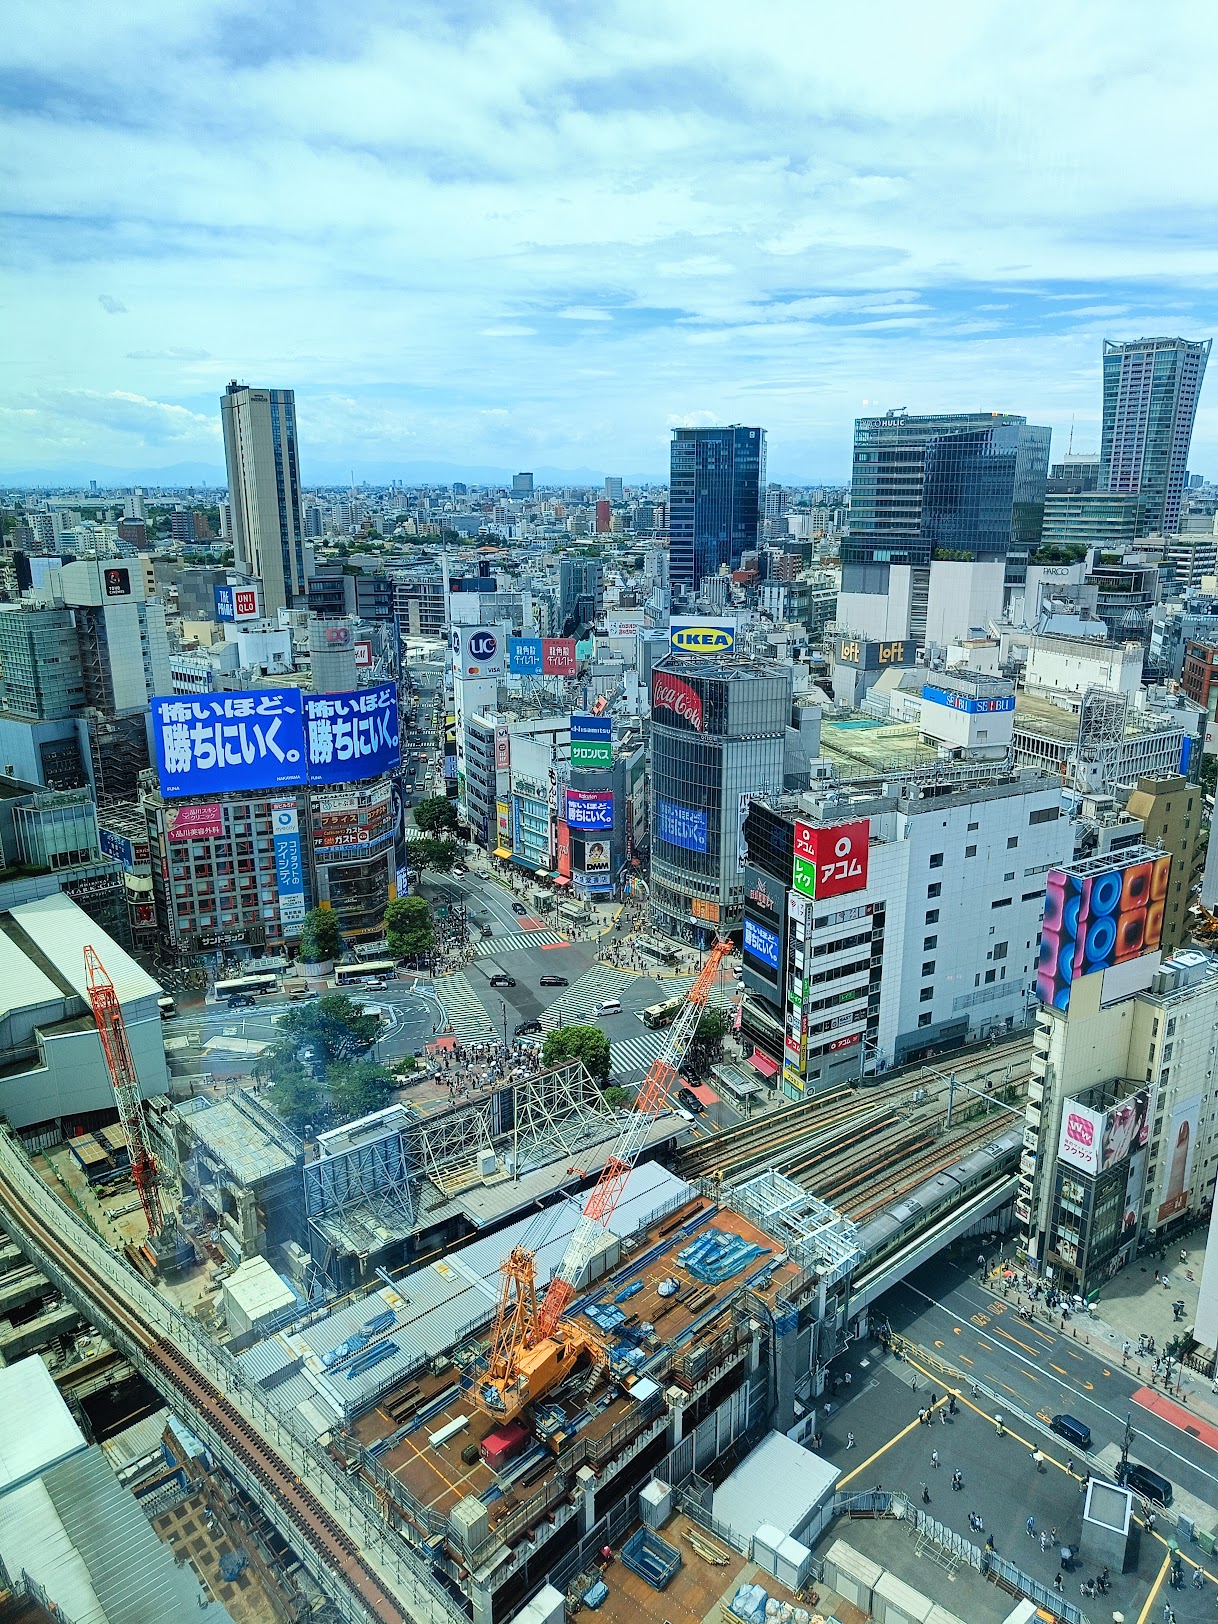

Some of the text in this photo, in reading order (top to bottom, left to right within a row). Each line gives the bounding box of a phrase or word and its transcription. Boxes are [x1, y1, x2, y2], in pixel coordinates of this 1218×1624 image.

[238, 594, 252, 602] UNI
[238, 604, 254, 612] QLO
[678, 634, 728, 646] IKEA
[514, 655, 540, 665] ダイレクト
[546, 656, 574, 666] ダイレクト
[158, 695, 296, 724] 怖いほど、
[305, 689, 396, 720] 怖いほど、
[946, 695, 968, 712] SEIBU
[977, 700, 1008, 712] SEIBU
[571, 725, 610, 734] Hisamitsu
[308, 708, 398, 764] 勝ちにいく。
[162, 716, 300, 774] 勝ちにいく。
[572, 748, 610, 760] サロンパス
[190, 807, 218, 816] 品川スキン
[568, 808, 612, 822] 勝ちにいく。
[176, 826, 220, 838] 品川美容外科
[335, 834, 356, 844] ガスト
[797, 838, 814, 856] アコム
[277, 842, 290, 886] アイシティ
[290, 841, 300, 884] コンタクトの
[587, 862, 608, 870] DMM
[821, 858, 862, 884] アコム
[202, 933, 244, 946] サンドラッグ
[745, 928, 778, 962] 勝ちにいく。
[790, 994, 801, 1003] レイク
[787, 1038, 800, 1052] アコム
[838, 1038, 850, 1048] アコム
[1064, 1144, 1092, 1162] ワクワク
